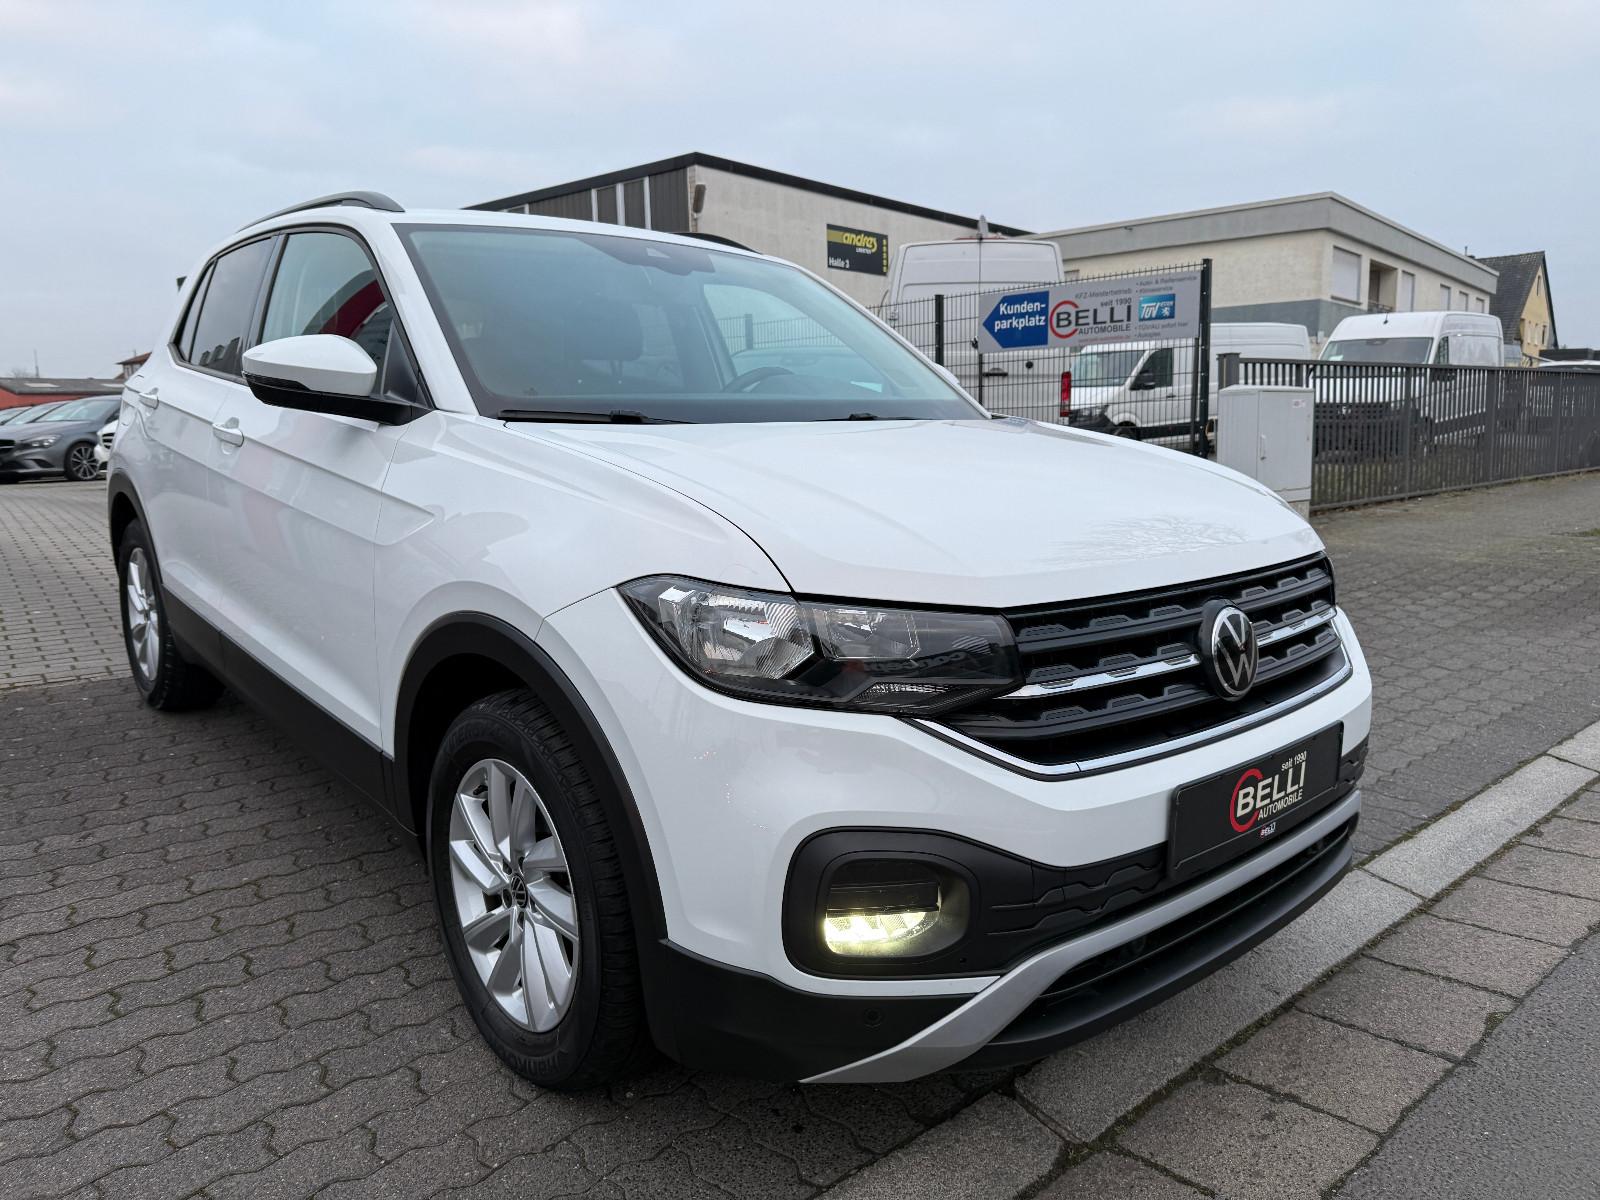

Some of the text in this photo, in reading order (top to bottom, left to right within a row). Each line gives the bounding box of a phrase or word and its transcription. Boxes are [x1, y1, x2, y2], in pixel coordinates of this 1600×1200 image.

[999, 301, 1047, 316] Kunden-
[1101, 297, 1132, 307] seit 1990
[994, 315, 1046, 333] parkplatz
[1056, 305, 1132, 328] BELLI
[1078, 323, 1132, 335] AUTOMOBILE
[1281, 751, 1307, 772] seit 1990
[1236, 761, 1306, 818] BELLI
[1258, 789, 1303, 821] AUTOMOBILE
